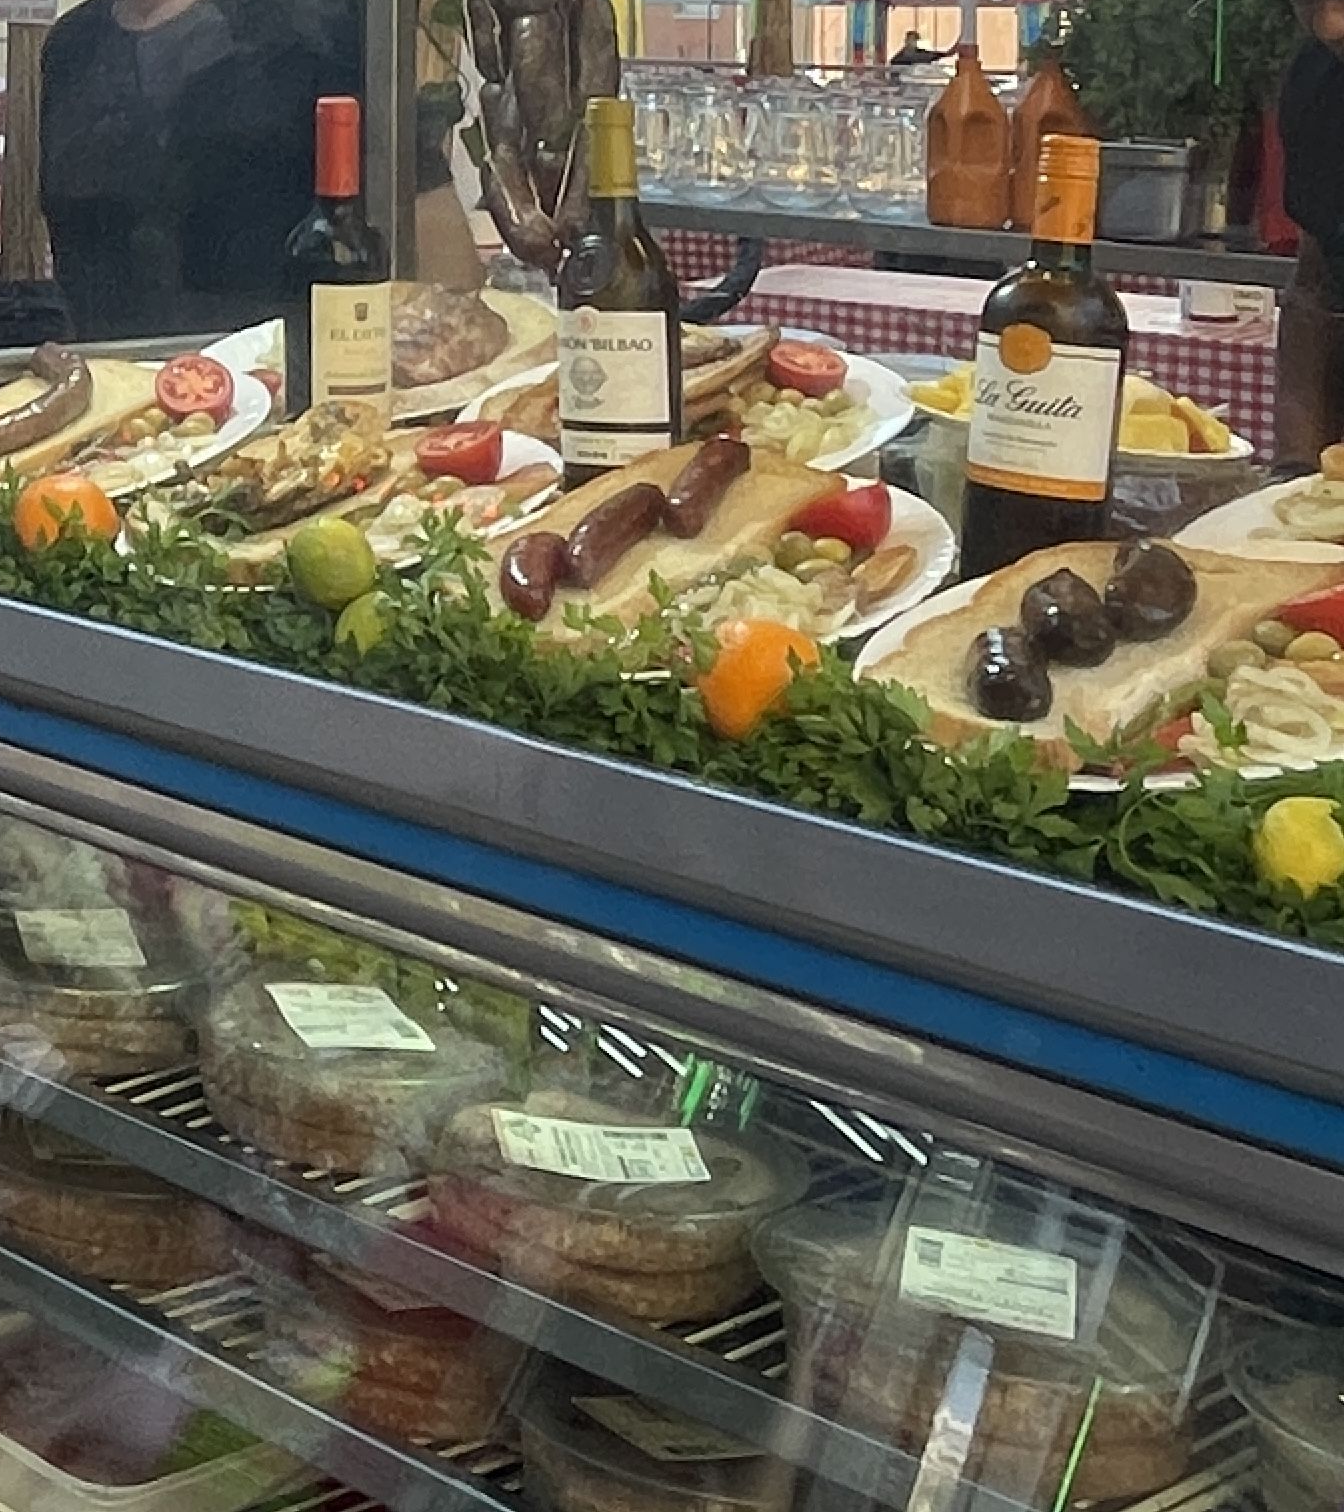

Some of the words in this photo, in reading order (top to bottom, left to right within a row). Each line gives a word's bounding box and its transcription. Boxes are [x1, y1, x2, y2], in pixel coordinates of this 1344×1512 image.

[589, 338, 655, 352] BILBAO
[975, 378, 1000, 408] La
[1004, 380, 1083, 419] Guita
